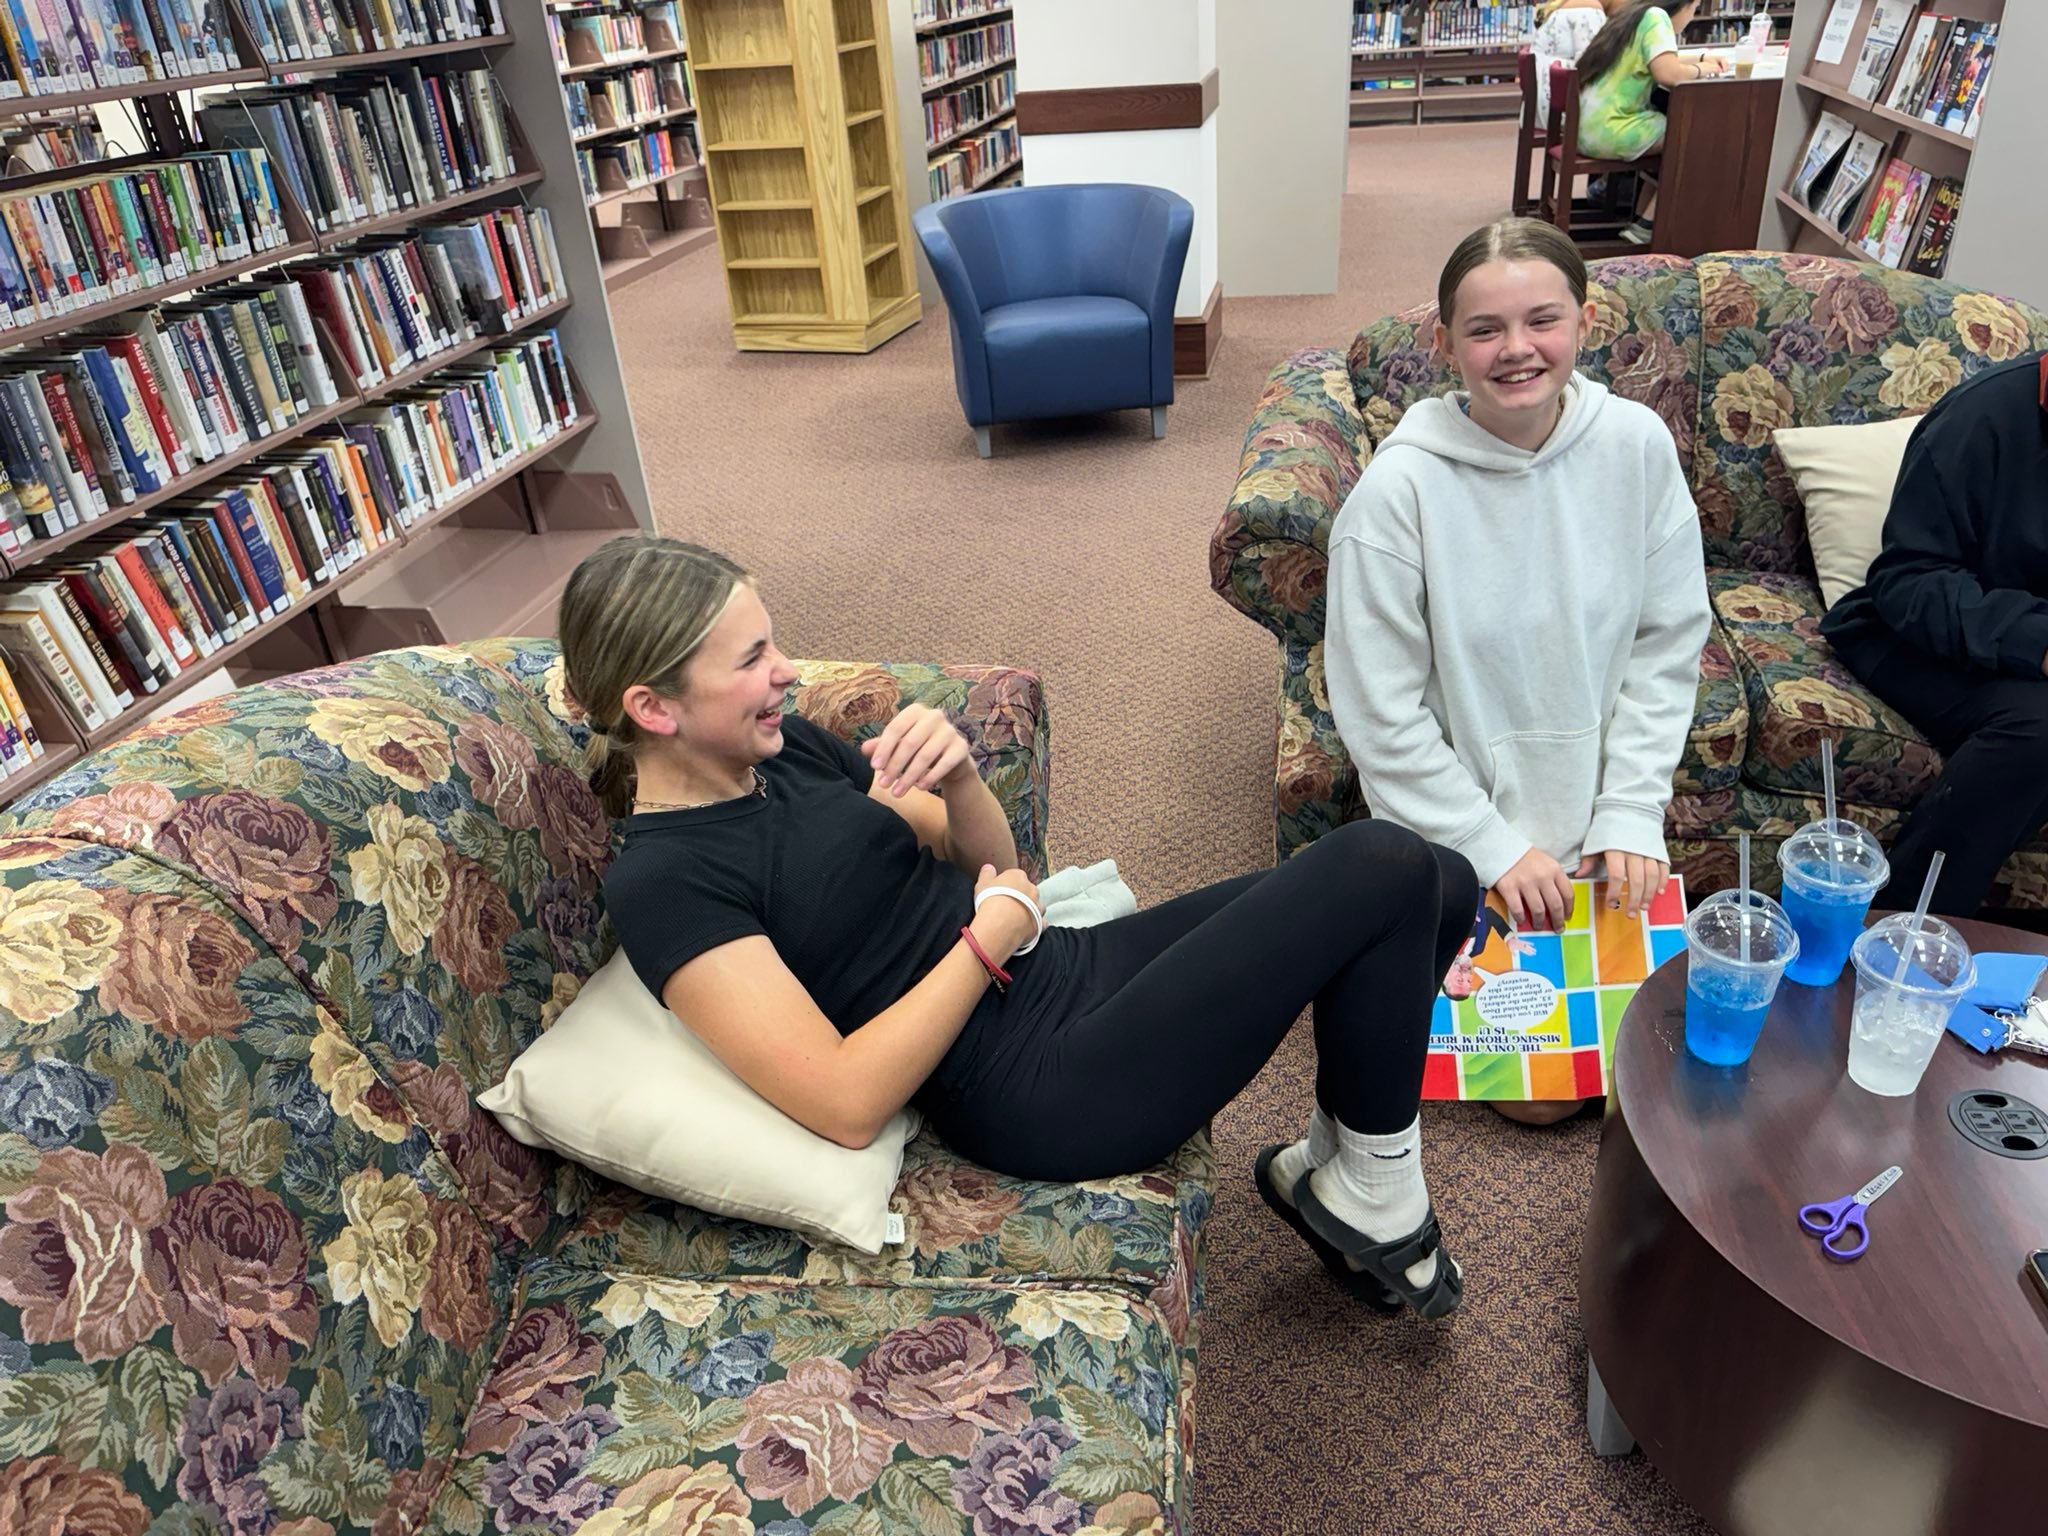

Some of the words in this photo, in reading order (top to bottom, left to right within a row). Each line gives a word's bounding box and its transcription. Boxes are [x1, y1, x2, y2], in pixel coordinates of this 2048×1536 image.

[426, 98, 451, 172] PRESIDENTS
[381, 254, 394, 274] TOM
[255, 311, 273, 347] KOREAN
[267, 347, 279, 366] WAR
[132, 342, 151, 375] AGENT
[146, 377, 159, 395] 110
[190, 341, 209, 373] TAKING
[202, 372, 217, 395] HEAT
[231, 353, 267, 425] Lusitania
[17, 382, 27, 395] THE
[22, 395, 37, 419] POWER
[30, 418, 40, 427] OF
[35, 430, 46, 443] AM
[39, 378, 64, 424] TIGER
[7, 410, 18, 427] AND
[13, 426, 32, 461] SOLDIERS
[67, 412, 84, 444] PLATOON
[162, 534, 181, 562] BLOOD
[175, 561, 192, 584] FEUD
[64, 593, 92, 632] HUNTING
[90, 641, 122, 685] EICHMANN
[1489, 992, 1511, 1000] friend
[1497, 978, 1529, 986] mystery?
[1520, 988, 1542, 997] phone
[1485, 1044, 1515, 1052] ONLY
[1519, 1044, 1541, 1052] THE
